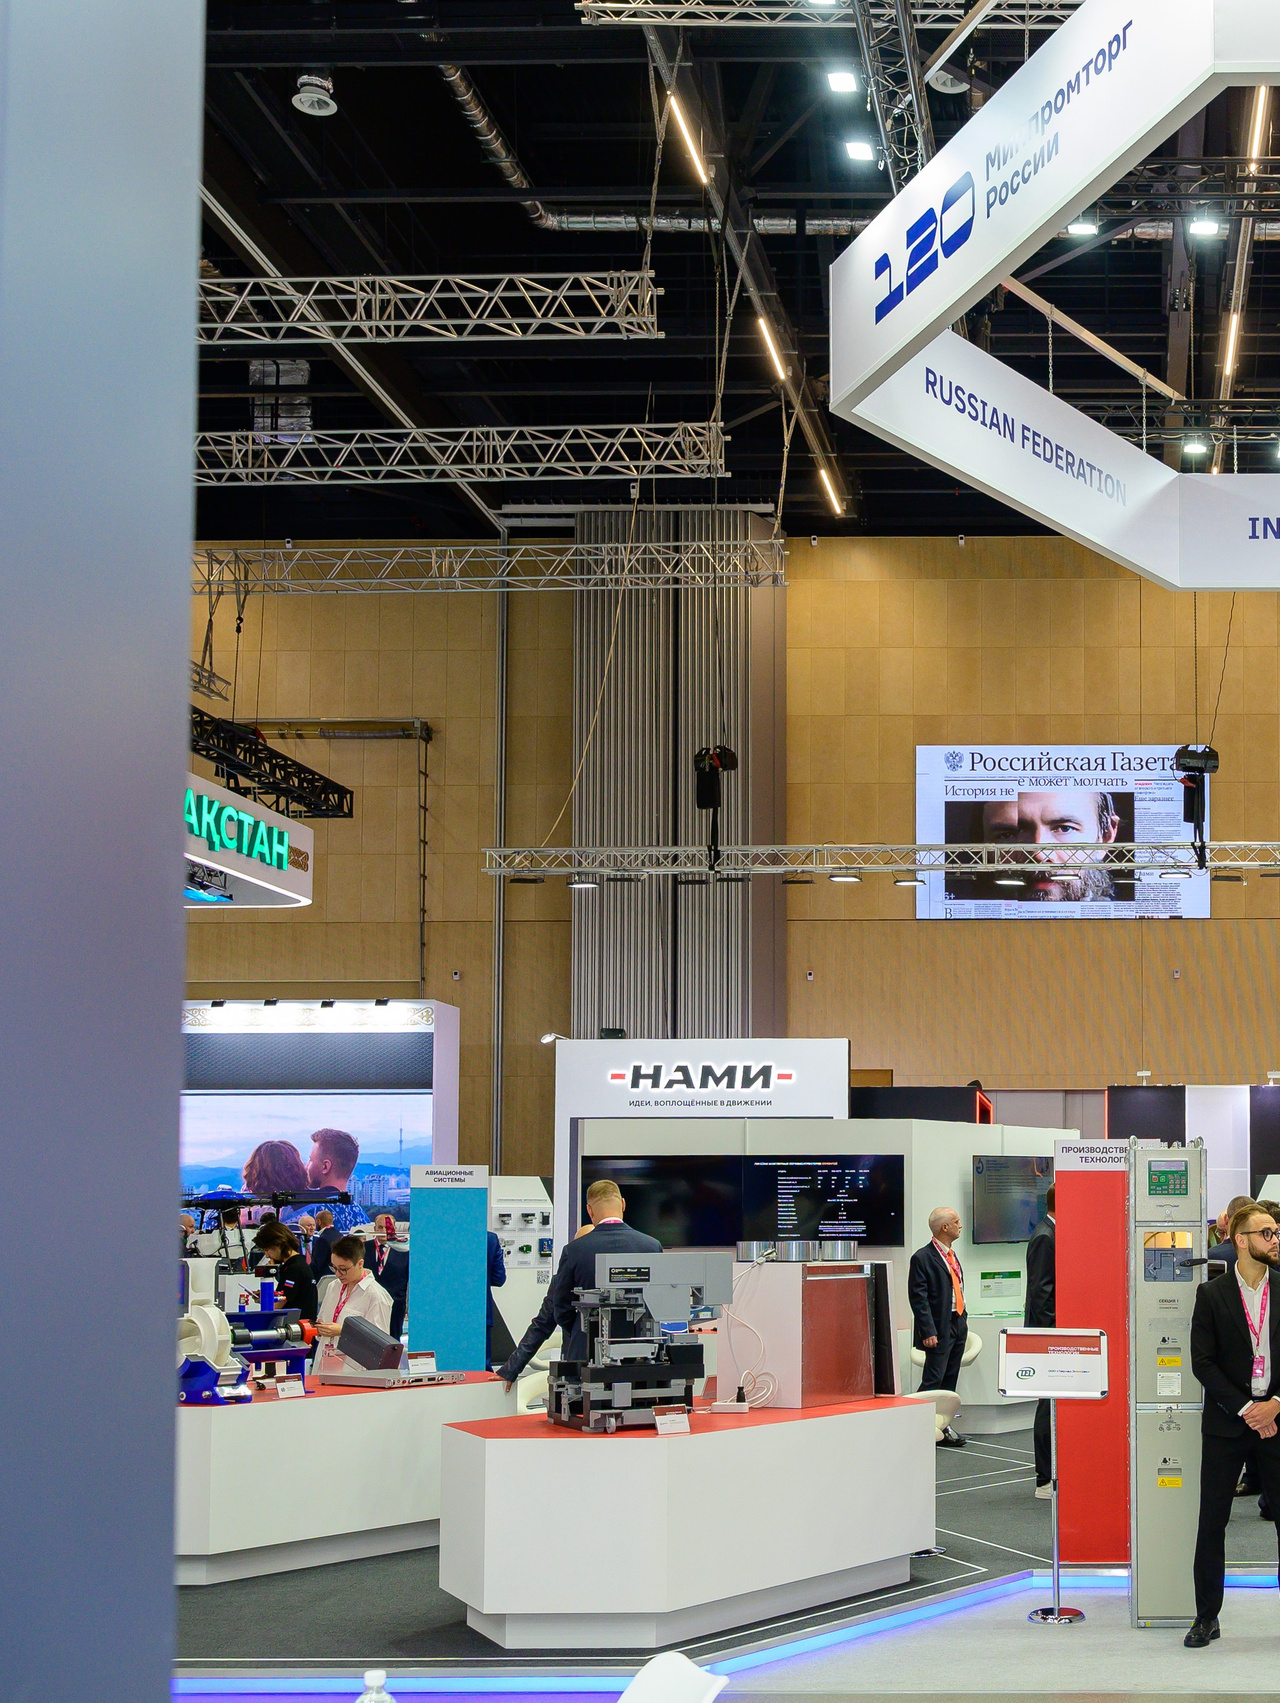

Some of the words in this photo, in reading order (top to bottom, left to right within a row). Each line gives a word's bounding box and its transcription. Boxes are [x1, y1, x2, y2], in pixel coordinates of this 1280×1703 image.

[986, 131, 1059, 219] России
[875, 170, 975, 325] 120
[925, 366, 1015, 443] RUSSIAN
[1021, 423, 1127, 507] FEDERATION
[969, 751, 1106, 772] Российская
[1028, 778, 1069, 787] может
[1073, 778, 1128, 787] молчать
[944, 785, 997, 799] История
[999, 788, 1015, 796] не
[629, 1065, 773, 1089] НАМИ
[628, 1100, 652, 1108] ИДЕИ,
[654, 1099, 718, 1108] ВОПЛОЩЁННЫЕ
[725, 1100, 772, 1108] ДВИЖЕНИИ
[1061, 1146, 1128, 1155] ПРОИЗВОДСТВЕ
[1079, 1156, 1126, 1164] ТЕХНОЛОГ
